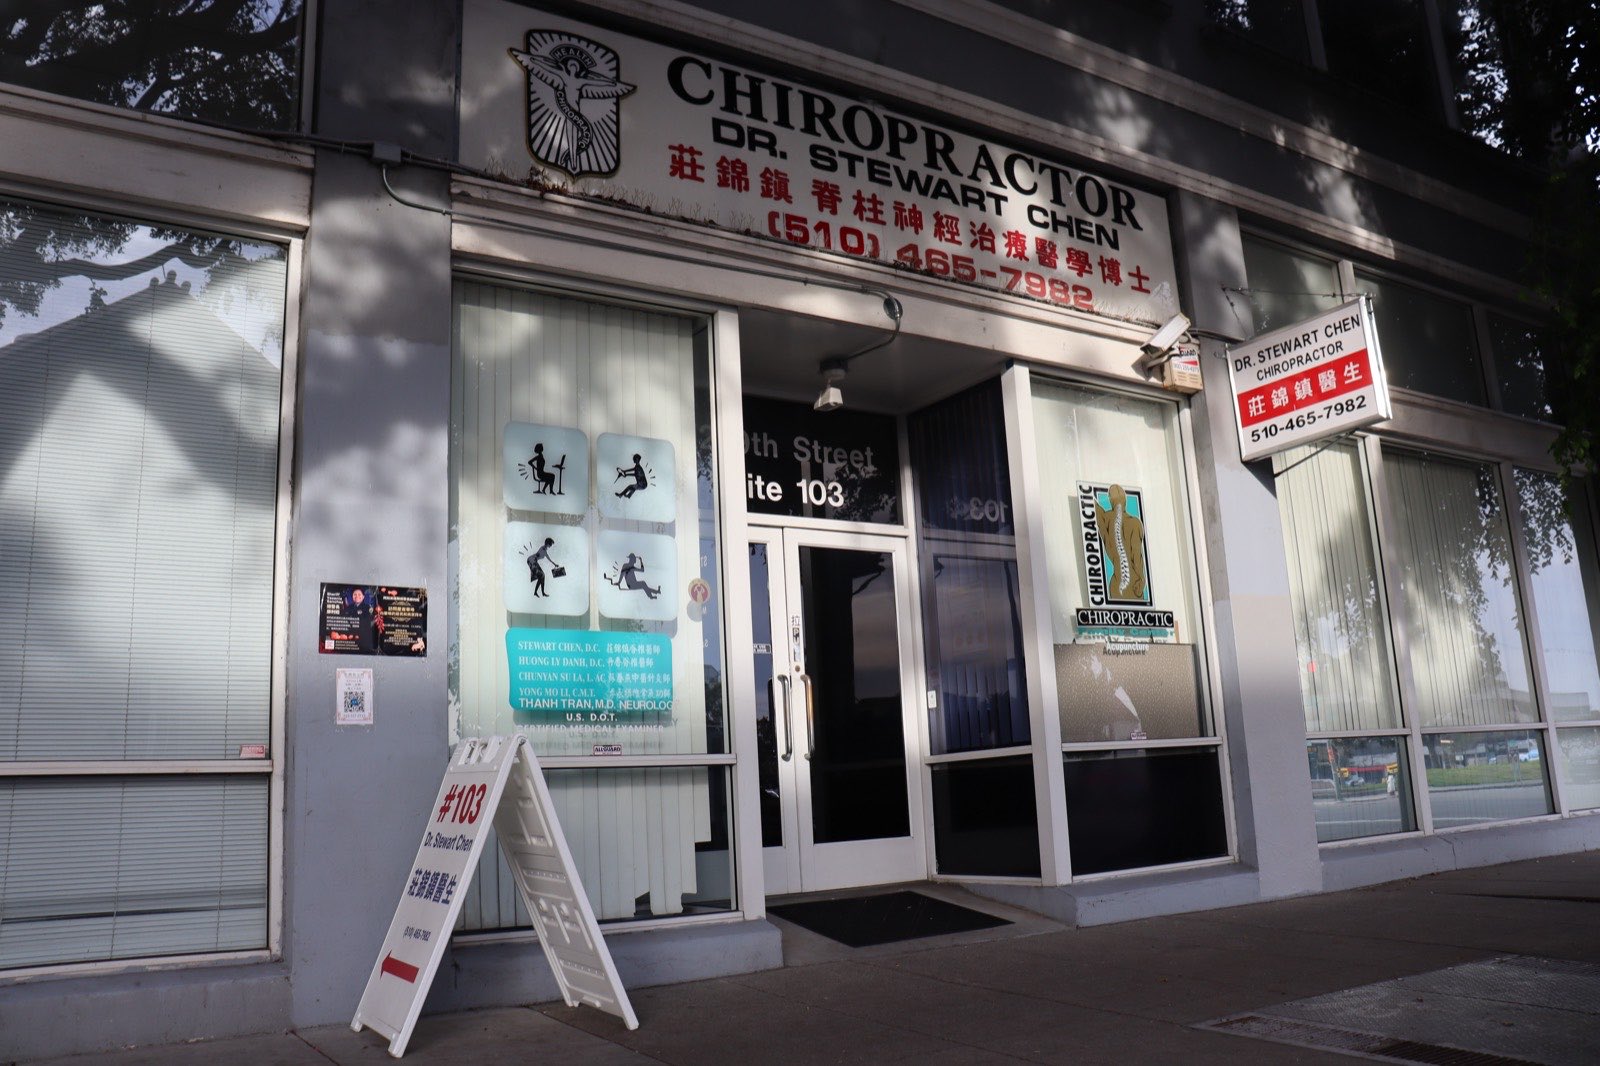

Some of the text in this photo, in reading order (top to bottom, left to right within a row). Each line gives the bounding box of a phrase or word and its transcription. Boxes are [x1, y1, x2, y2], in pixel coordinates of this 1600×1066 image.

[554, 48, 593, 66] HEALTH
[667, 56, 1143, 231] CHIROPRACTOR
[712, 117, 1120, 251] DR. STEWART CHEN
[768, 211, 1095, 311] (510) 465-7982
[1234, 314, 1361, 373] DR. STEWART CHEN
[1256, 340, 1344, 382] CHIROPRACTOR
[1251, 394, 1367, 443] 510-465-7982
[793, 436, 874, 470] Street
[796, 478, 845, 508] 103
[1078, 610, 1173, 627] CHIROPRACTIC
[518, 640, 601, 652] STEWART CHEN, D.C.
[1106, 642, 1150, 652] Acupuncture
[518, 656, 605, 668] HUONG LY DANH, D.C.
[518, 671, 558, 681] CHUNYAN
[560, 672, 571, 681] SU
[519, 687, 543, 696] YONG
[544, 688, 558, 696] MO
[520, 698, 680, 710] THANH TRAN, M.D. NEUROLOG
[566, 713, 618, 722] U.S. D.O.T.
[518, 724, 664, 733] CERTIFIED MEDICAL EXAMINER
[437, 783, 487, 824] #103
[433, 832, 458, 850] Stewart
[456, 833, 473, 852] Chen
